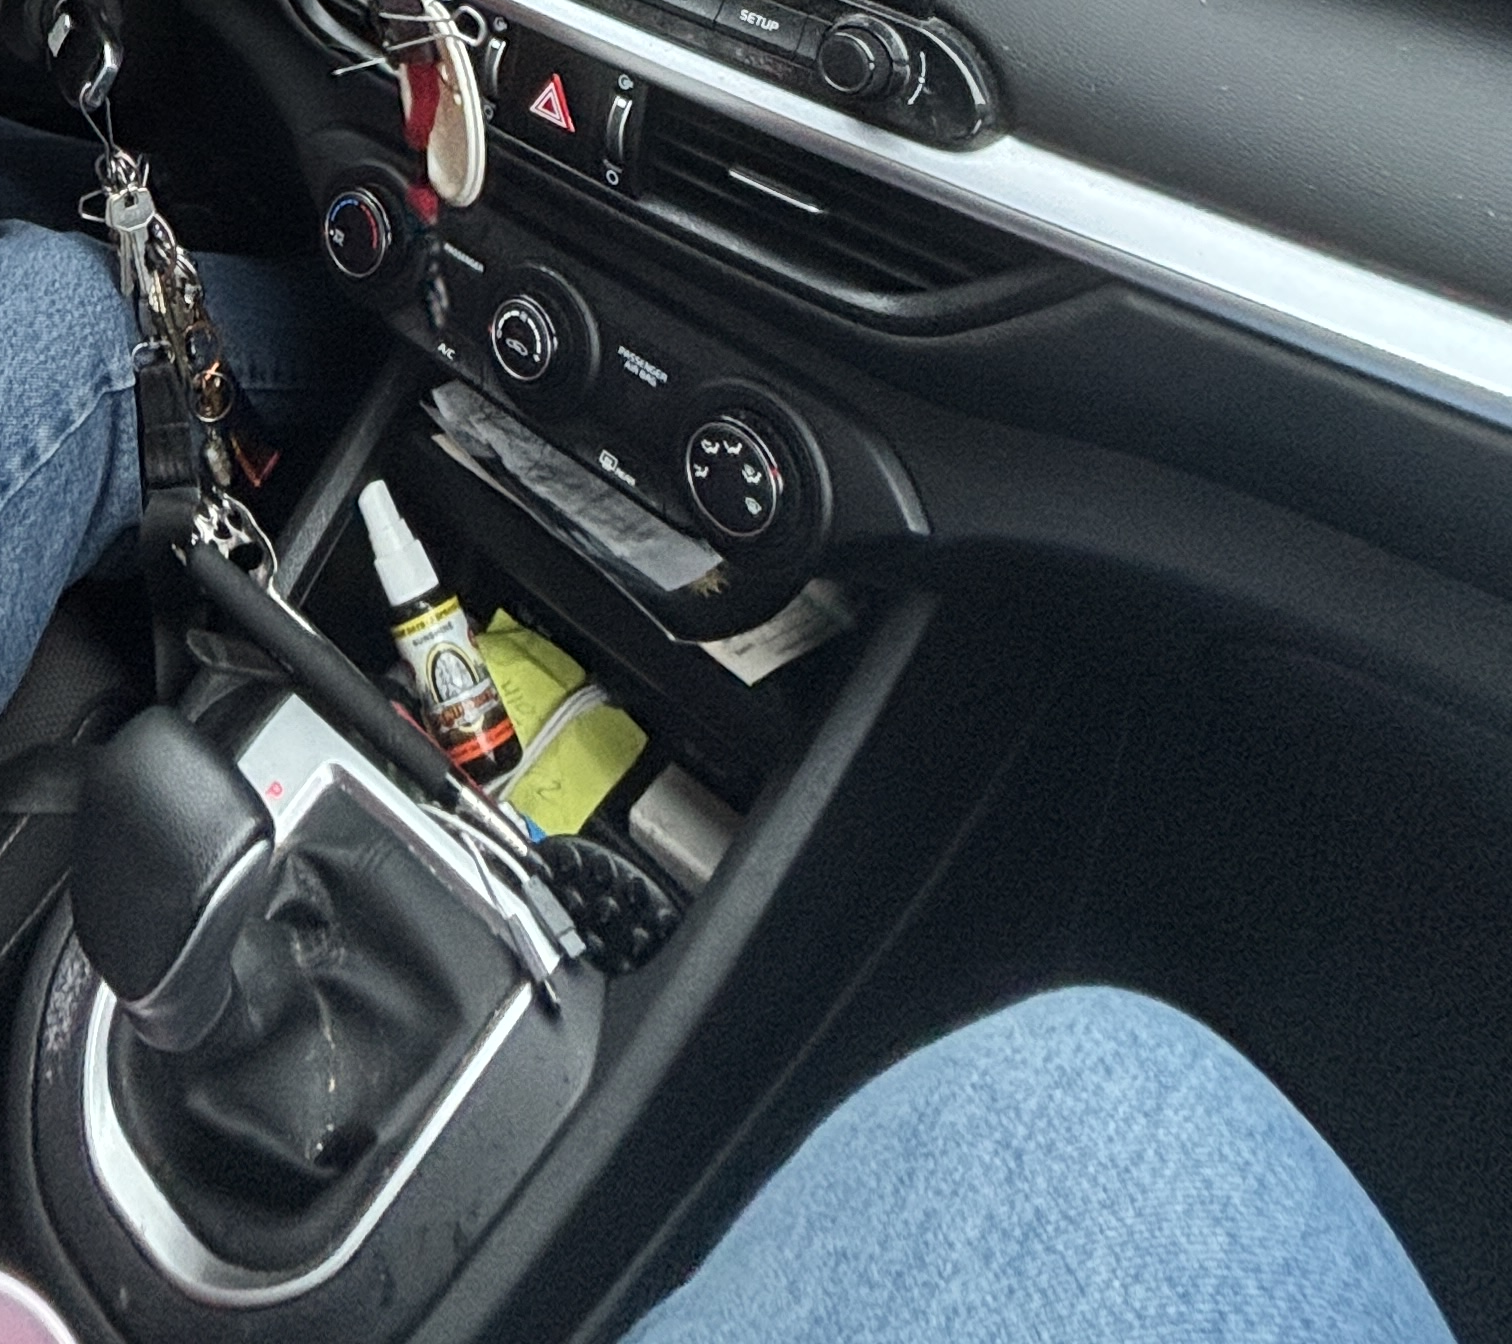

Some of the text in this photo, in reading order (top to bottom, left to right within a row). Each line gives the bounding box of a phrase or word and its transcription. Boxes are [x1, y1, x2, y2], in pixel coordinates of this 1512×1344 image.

[739, 8, 781, 33] SETUP
[437, 342, 456, 361] A/C
[265, 780, 283, 797] P
